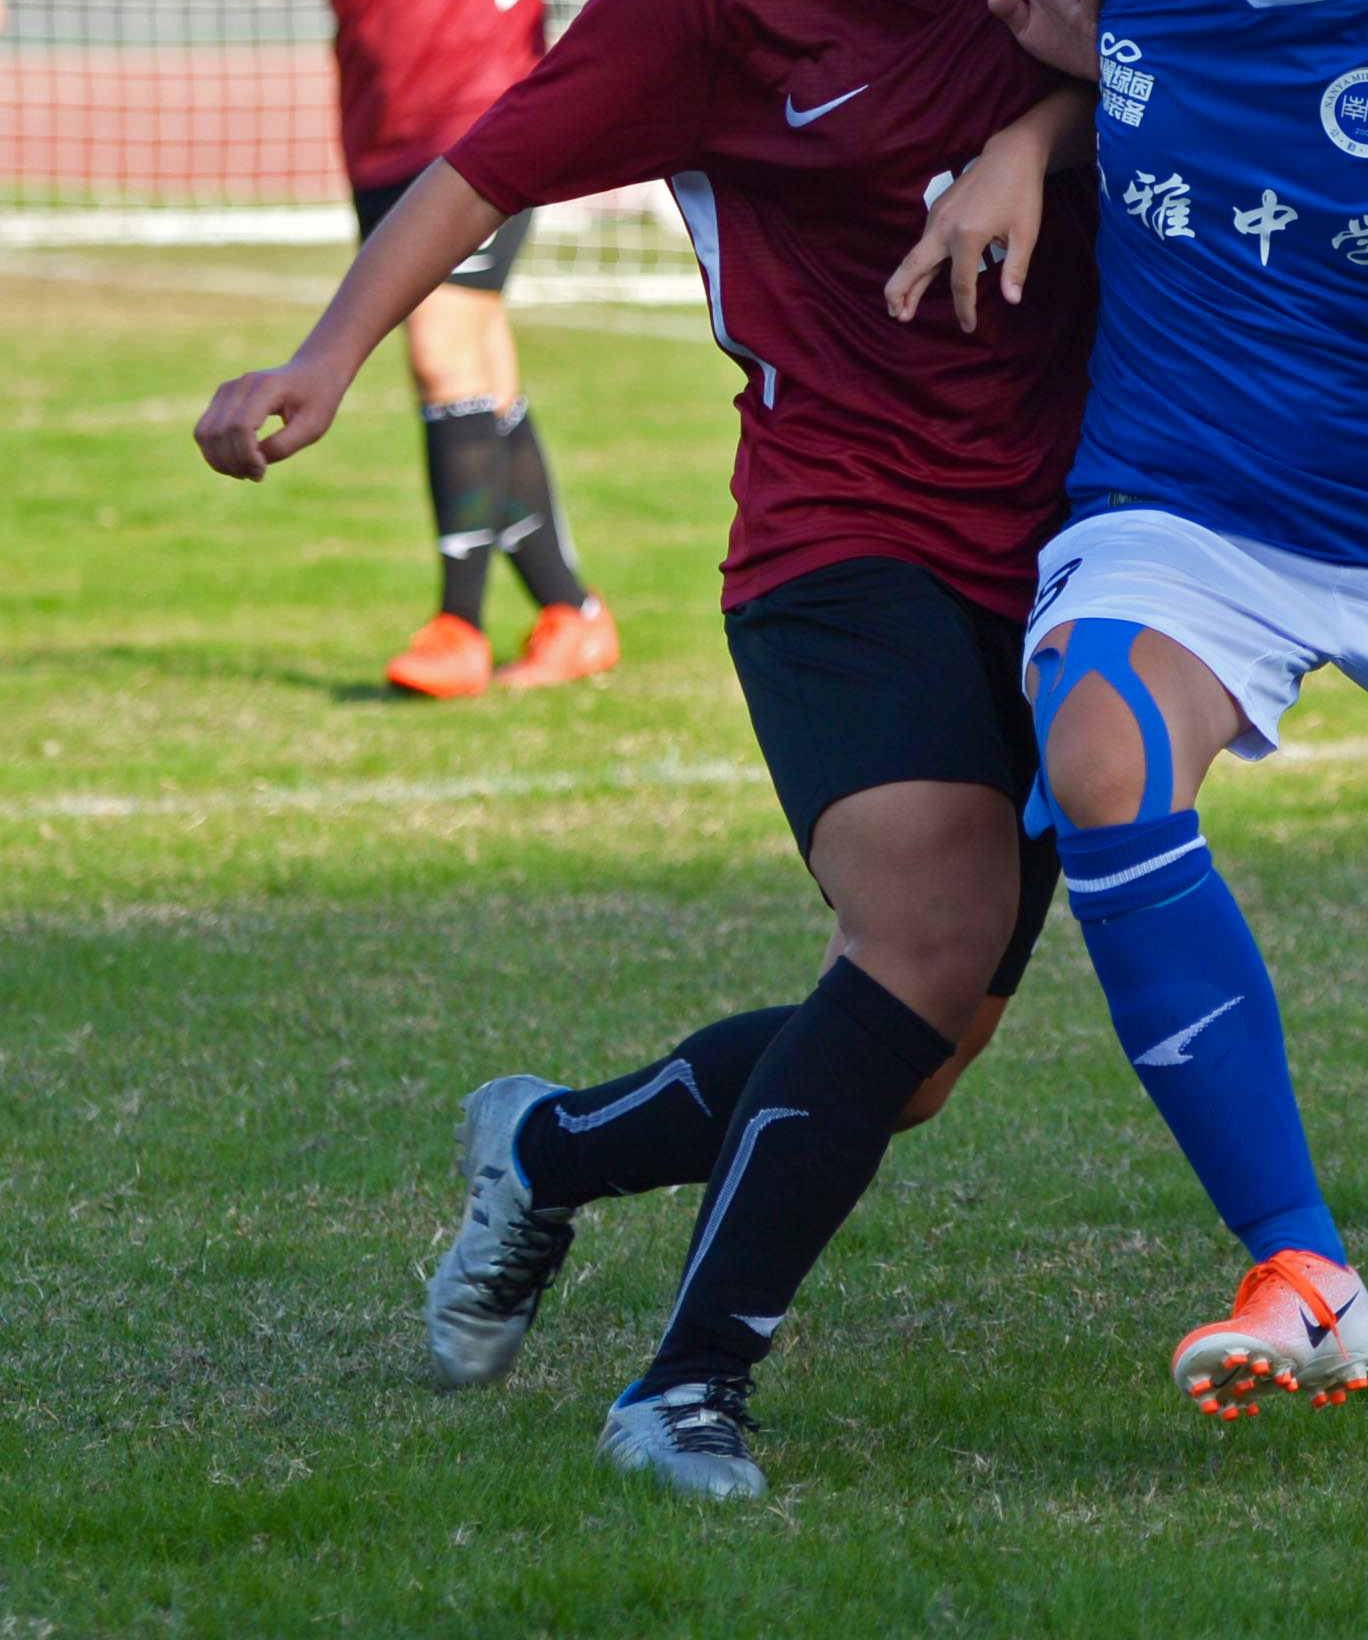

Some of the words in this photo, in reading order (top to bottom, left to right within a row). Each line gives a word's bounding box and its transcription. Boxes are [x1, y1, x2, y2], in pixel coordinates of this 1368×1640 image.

[1099, 55, 1155, 102] 翼绿茵
[1324, 78, 1351, 109] NANYA
